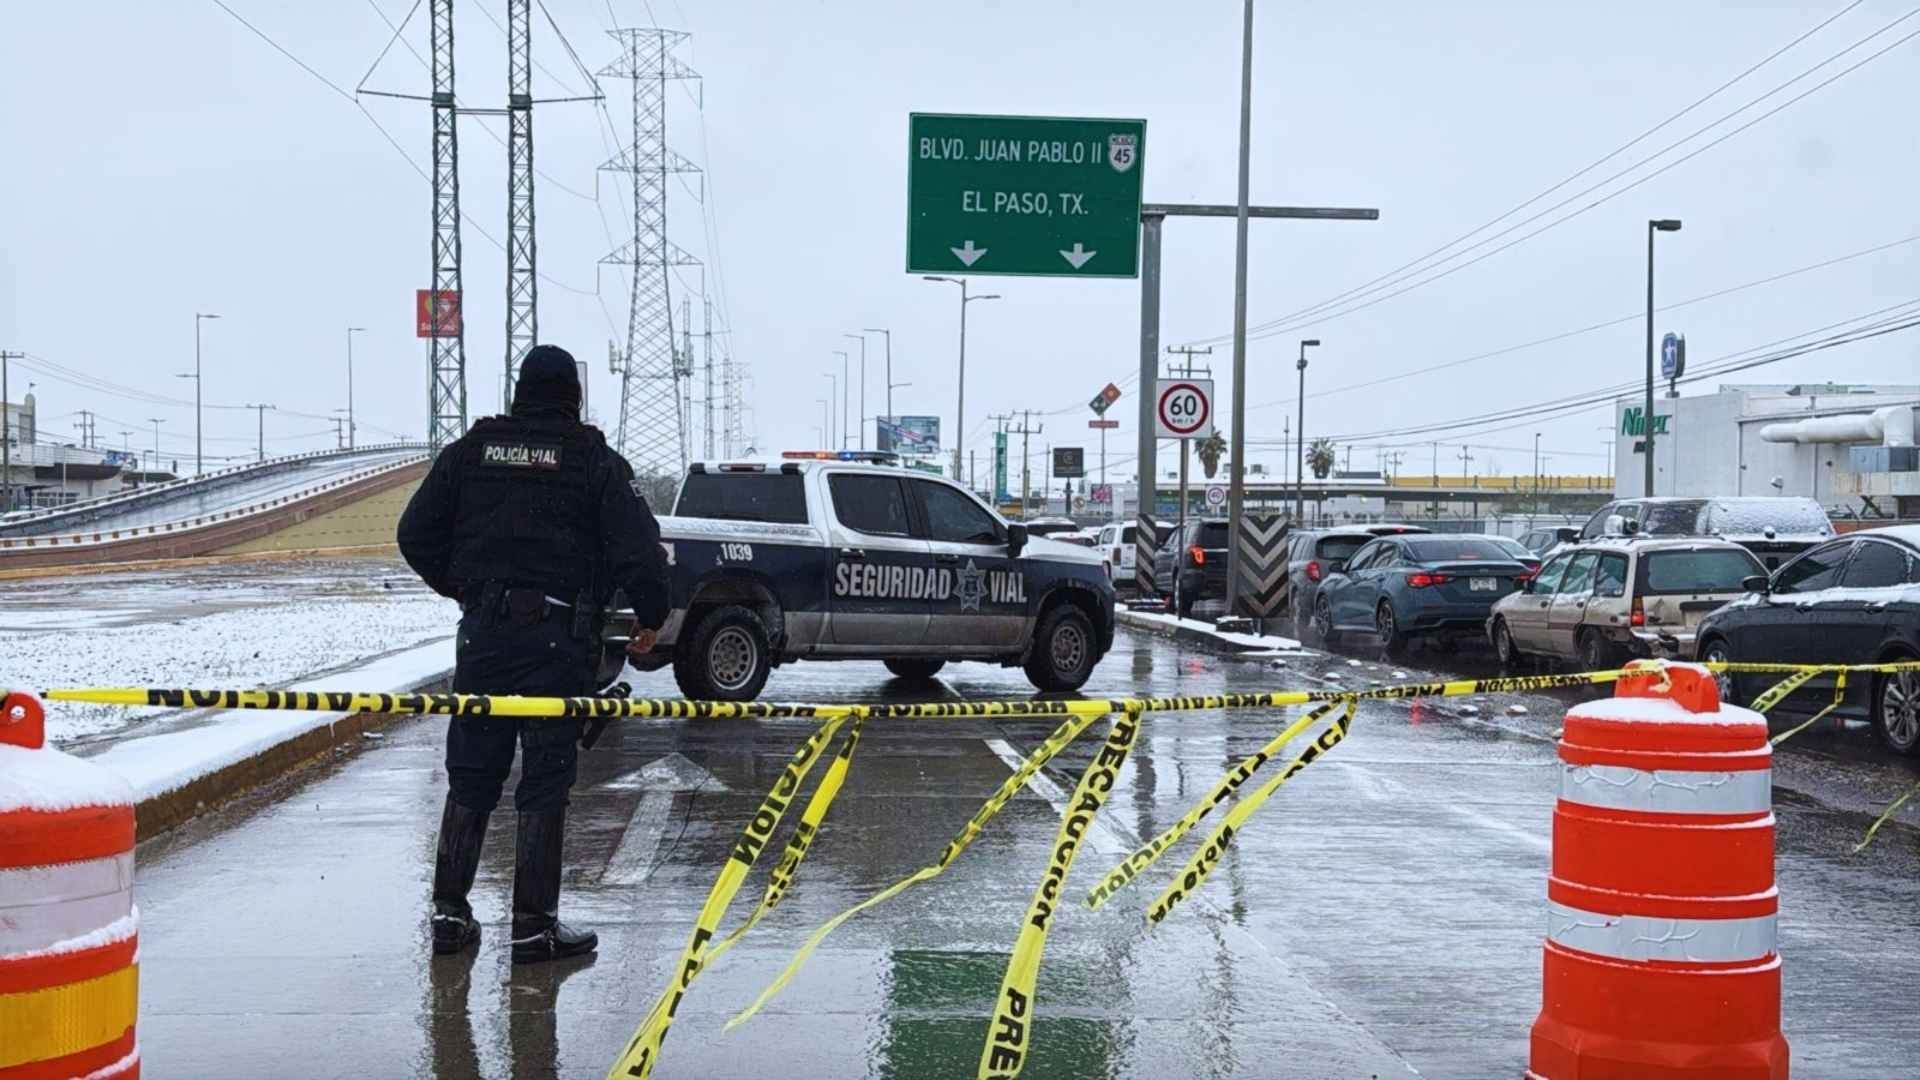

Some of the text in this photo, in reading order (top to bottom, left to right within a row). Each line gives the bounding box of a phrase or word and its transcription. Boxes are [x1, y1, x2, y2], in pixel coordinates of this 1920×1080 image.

[919, 137, 1101, 164] BLVD. JUAN PABLO II
[1113, 148, 1131, 164] 45
[962, 191, 1089, 217] EL PASO, TX.
[1170, 395, 1197, 416] 60
[485, 444, 529, 462] POLICÍA
[720, 543, 753, 561] 1039
[834, 562, 1027, 603] SEGURIDAD VIAL
[987, 986, 1028, 1080] PRE
